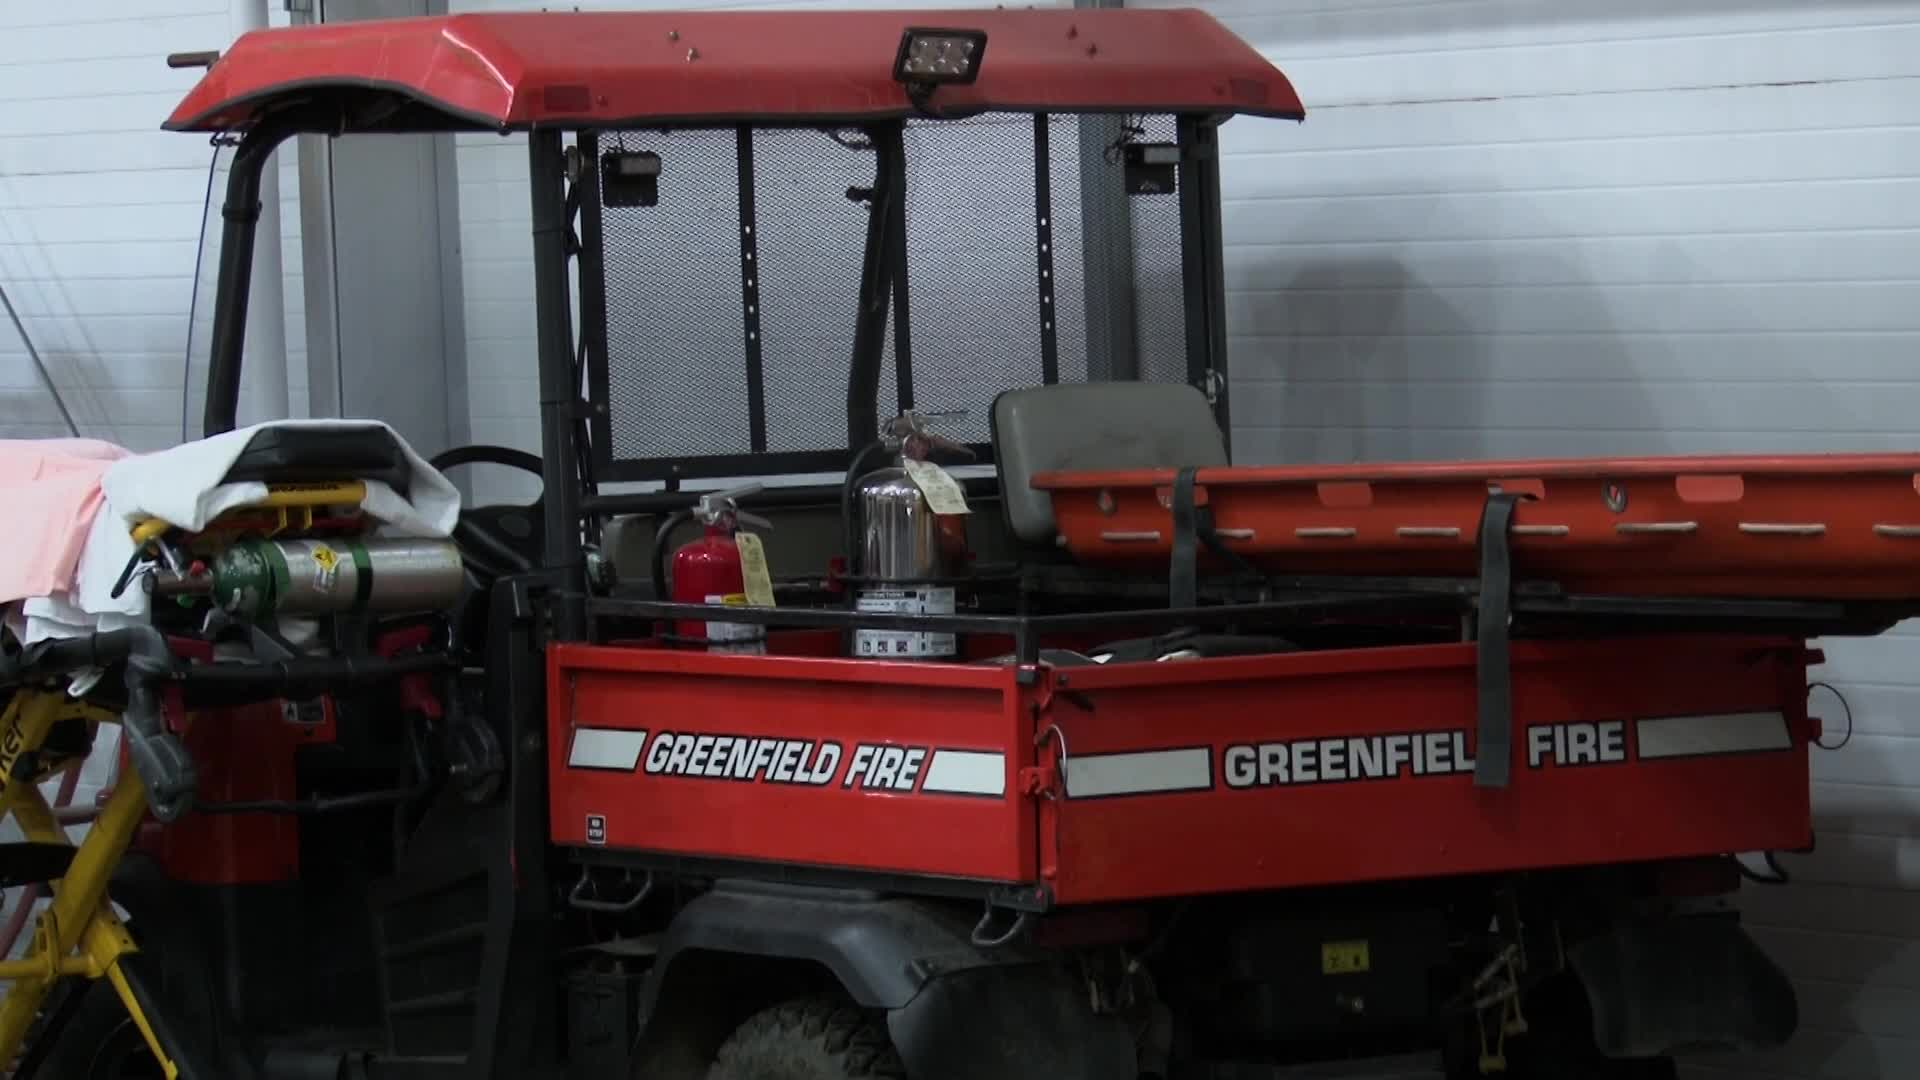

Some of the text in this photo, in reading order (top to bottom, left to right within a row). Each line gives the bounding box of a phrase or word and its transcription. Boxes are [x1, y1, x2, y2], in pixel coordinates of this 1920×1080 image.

[645, 733, 925, 790] GREENFIELD FIRE
[1224, 720, 1625, 787] GREENFIEL FIRE
